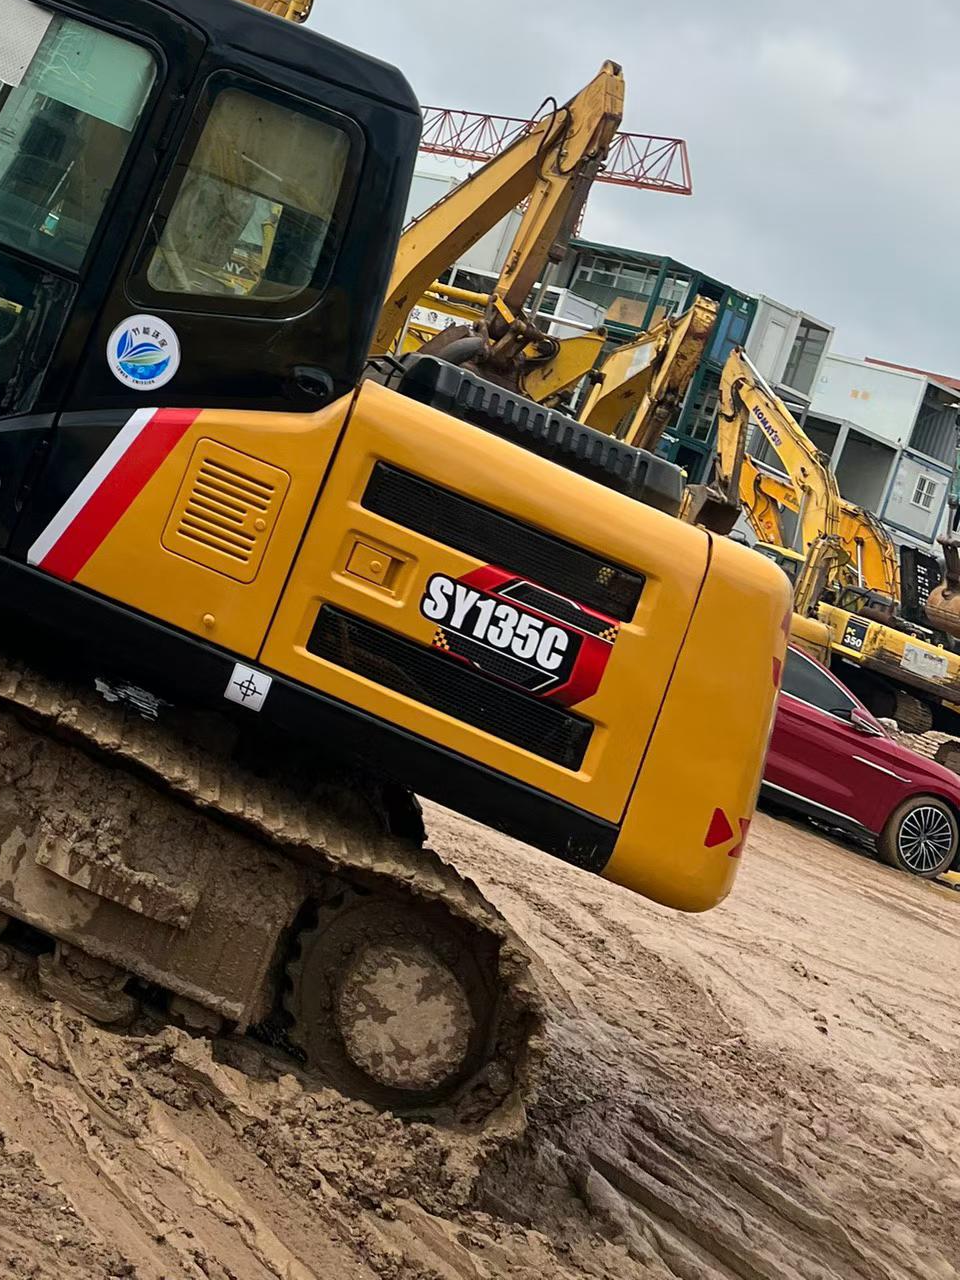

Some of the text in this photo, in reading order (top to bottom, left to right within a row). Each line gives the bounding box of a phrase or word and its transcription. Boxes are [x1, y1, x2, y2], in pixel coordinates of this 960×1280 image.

[751, 405, 783, 447] KOMATSU
[422, 576, 570, 670] SY135C
[845, 626, 857, 636] PC
[843, 634, 863, 648] 350
